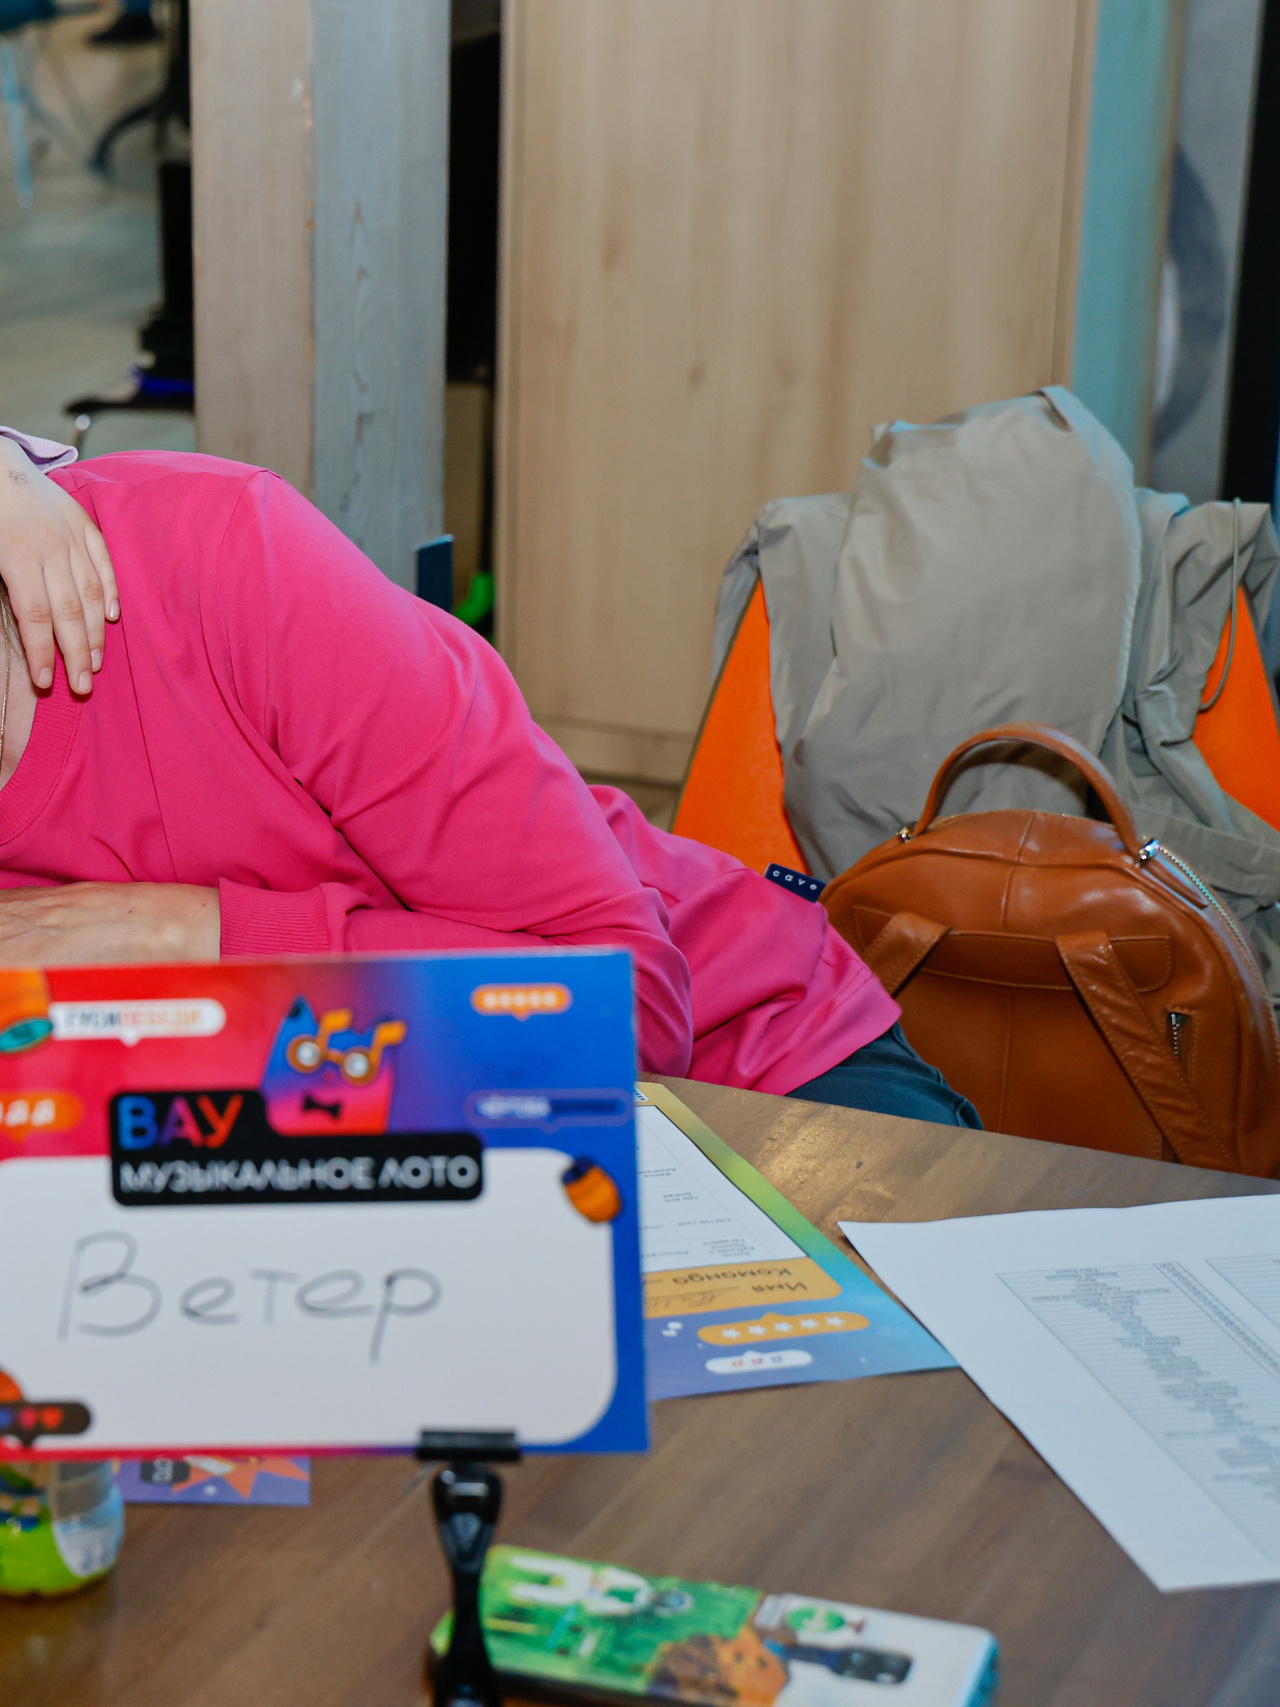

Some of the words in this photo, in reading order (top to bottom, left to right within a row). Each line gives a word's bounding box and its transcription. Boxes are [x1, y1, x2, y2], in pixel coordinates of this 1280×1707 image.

[773, 870, 817, 890] cave
[118, 1093, 244, 1150] ВАУ
[119, 1156, 376, 1193] МУЗЫКАЛЬНОЕ
[378, 1154, 480, 1190] ЛОТО
[672, 1267, 793, 1285] Команда
[751, 1280, 808, 1293] Имя
[56, 1229, 443, 1366] Ветер
